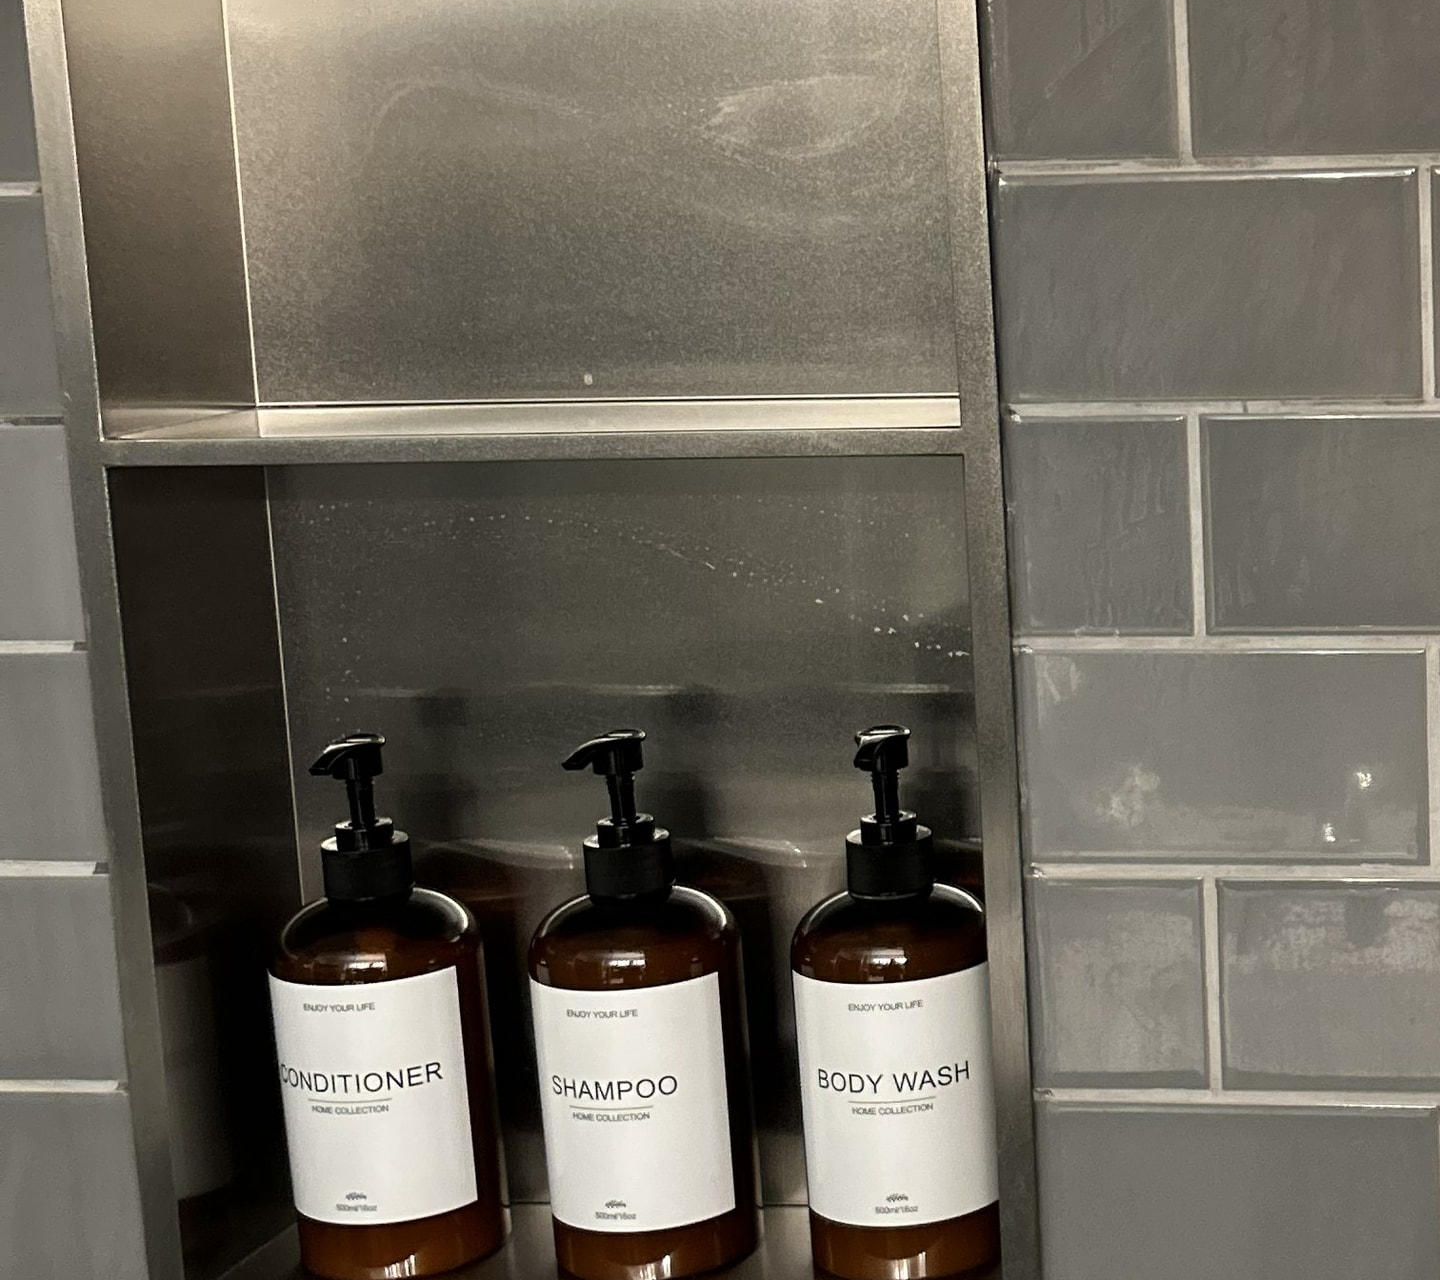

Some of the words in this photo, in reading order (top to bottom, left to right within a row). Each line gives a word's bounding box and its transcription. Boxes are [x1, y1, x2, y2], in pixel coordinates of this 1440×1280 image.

[303, 1003, 328, 1013] ENJOY
[329, 1003, 355, 1013] YOUR
[356, 1002, 376, 1012] LIFE
[848, 1003, 876, 1012] ENJOY
[877, 1002, 903, 1012] YOUR
[904, 999, 924, 1009] LIFE
[566, 1009, 591, 1019] ENJOY
[592, 1010, 618, 1019] YOUR
[619, 1008, 638, 1018] LIFE
[280, 1061, 444, 1094] CONDITIONER
[817, 1068, 884, 1094] BODY
[892, 1060, 970, 1093] WASH
[551, 1074, 678, 1101] SHAMPOO
[311, 1105, 334, 1114] HOME
[334, 1104, 390, 1115] COLLECTION
[851, 1106, 876, 1116] HOME
[878, 1103, 934, 1116] COLLECTION
[572, 1111, 595, 1121] HOME
[595, 1111, 651, 1122] COLLECTION
